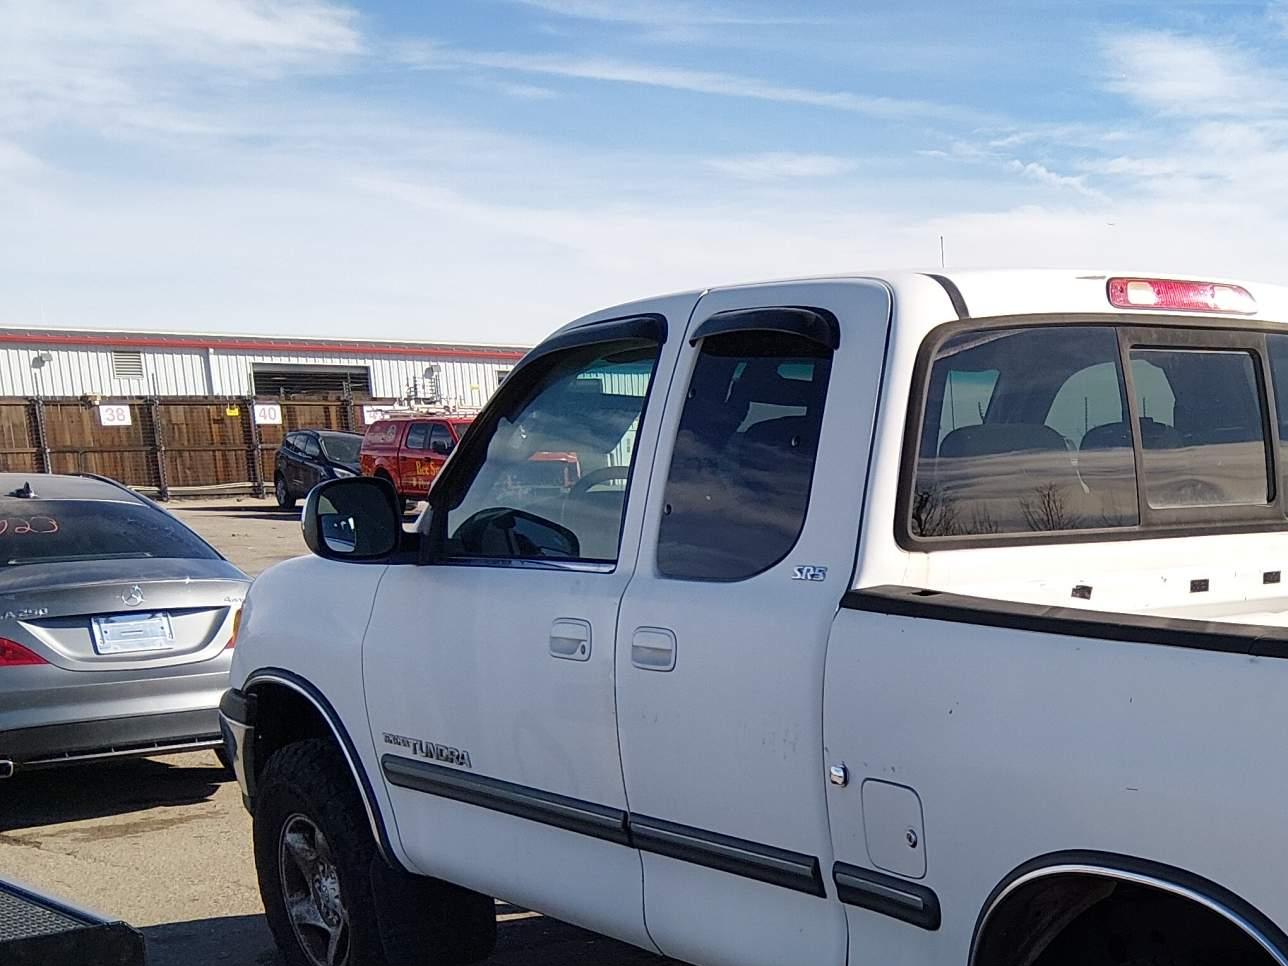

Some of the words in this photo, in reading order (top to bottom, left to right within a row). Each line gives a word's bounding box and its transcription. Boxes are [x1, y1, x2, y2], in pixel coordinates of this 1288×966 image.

[106, 408, 126, 421] 38
[259, 408, 277, 420] 40
[792, 566, 827, 582] SR5
[410, 739, 472, 768] TUNDRA
